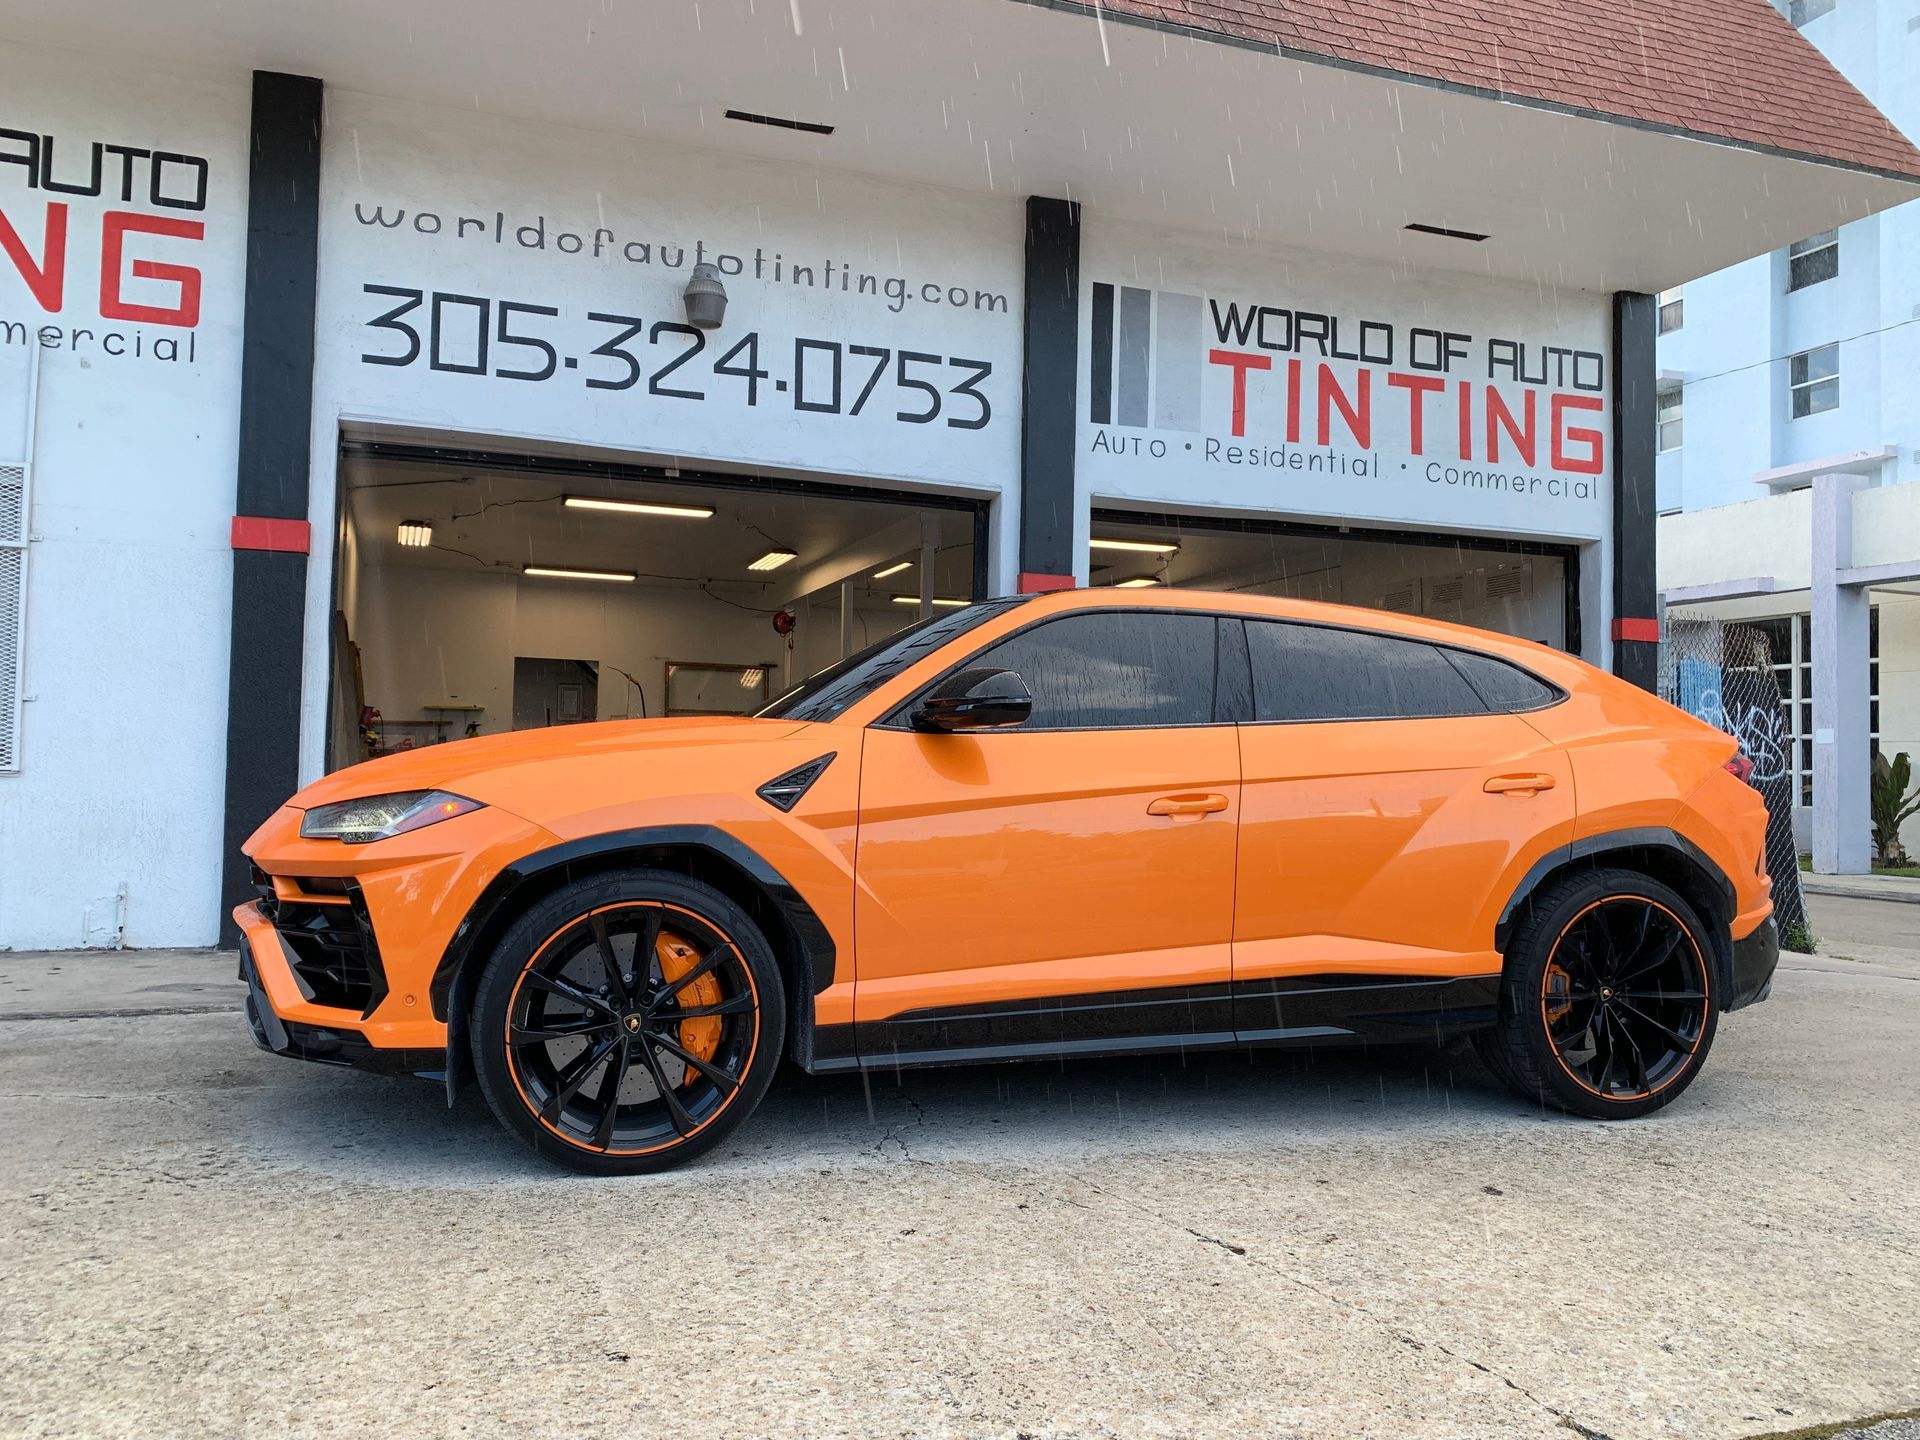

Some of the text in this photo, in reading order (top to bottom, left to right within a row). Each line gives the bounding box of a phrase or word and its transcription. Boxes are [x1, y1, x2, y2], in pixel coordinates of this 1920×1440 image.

[354, 203, 1008, 313] worldofautotinting.com
[1209, 298, 1603, 391] WORLD OF AUTO
[1208, 348, 1603, 475] TINTING
[1206, 437, 1378, 478] Residential
[1426, 462, 1597, 500] Commercial
